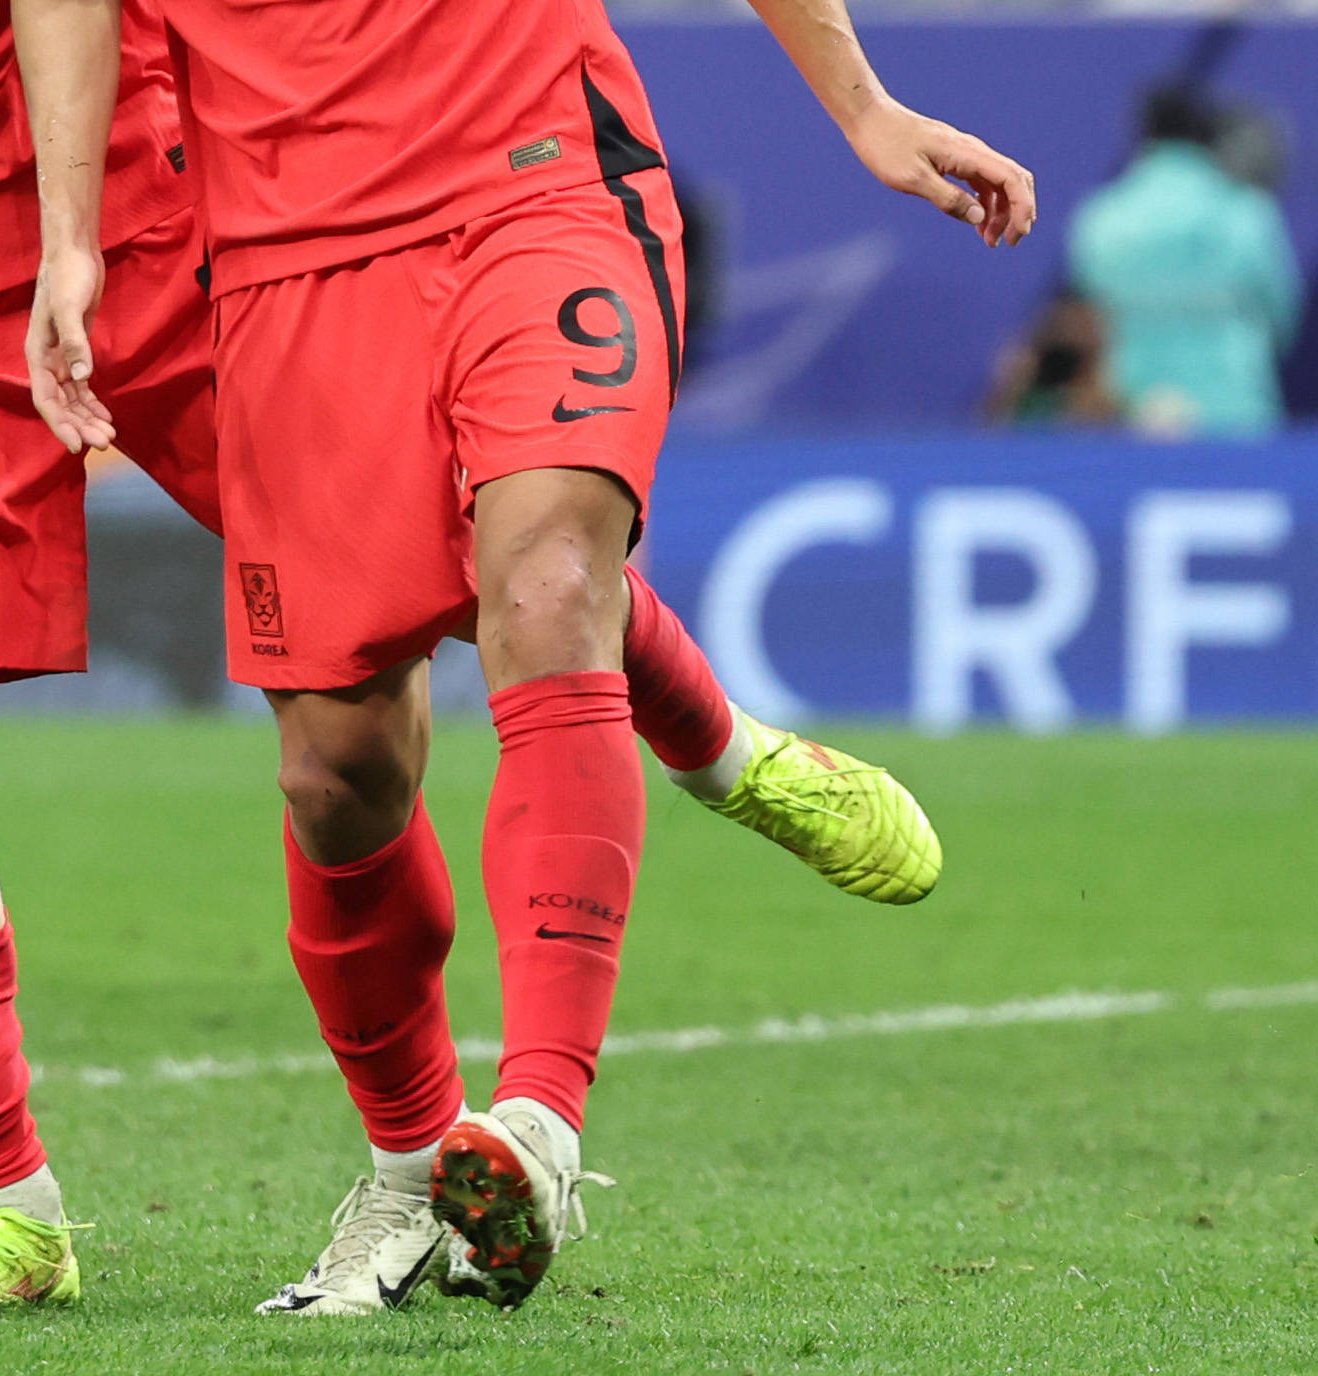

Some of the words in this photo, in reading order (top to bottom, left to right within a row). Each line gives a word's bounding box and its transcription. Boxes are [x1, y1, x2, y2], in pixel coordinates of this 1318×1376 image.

[557, 287, 638, 387] 9
[699, 479, 1291, 736] CRF
[251, 642, 289, 657] KOREA
[528, 892, 626, 925] KOREA
